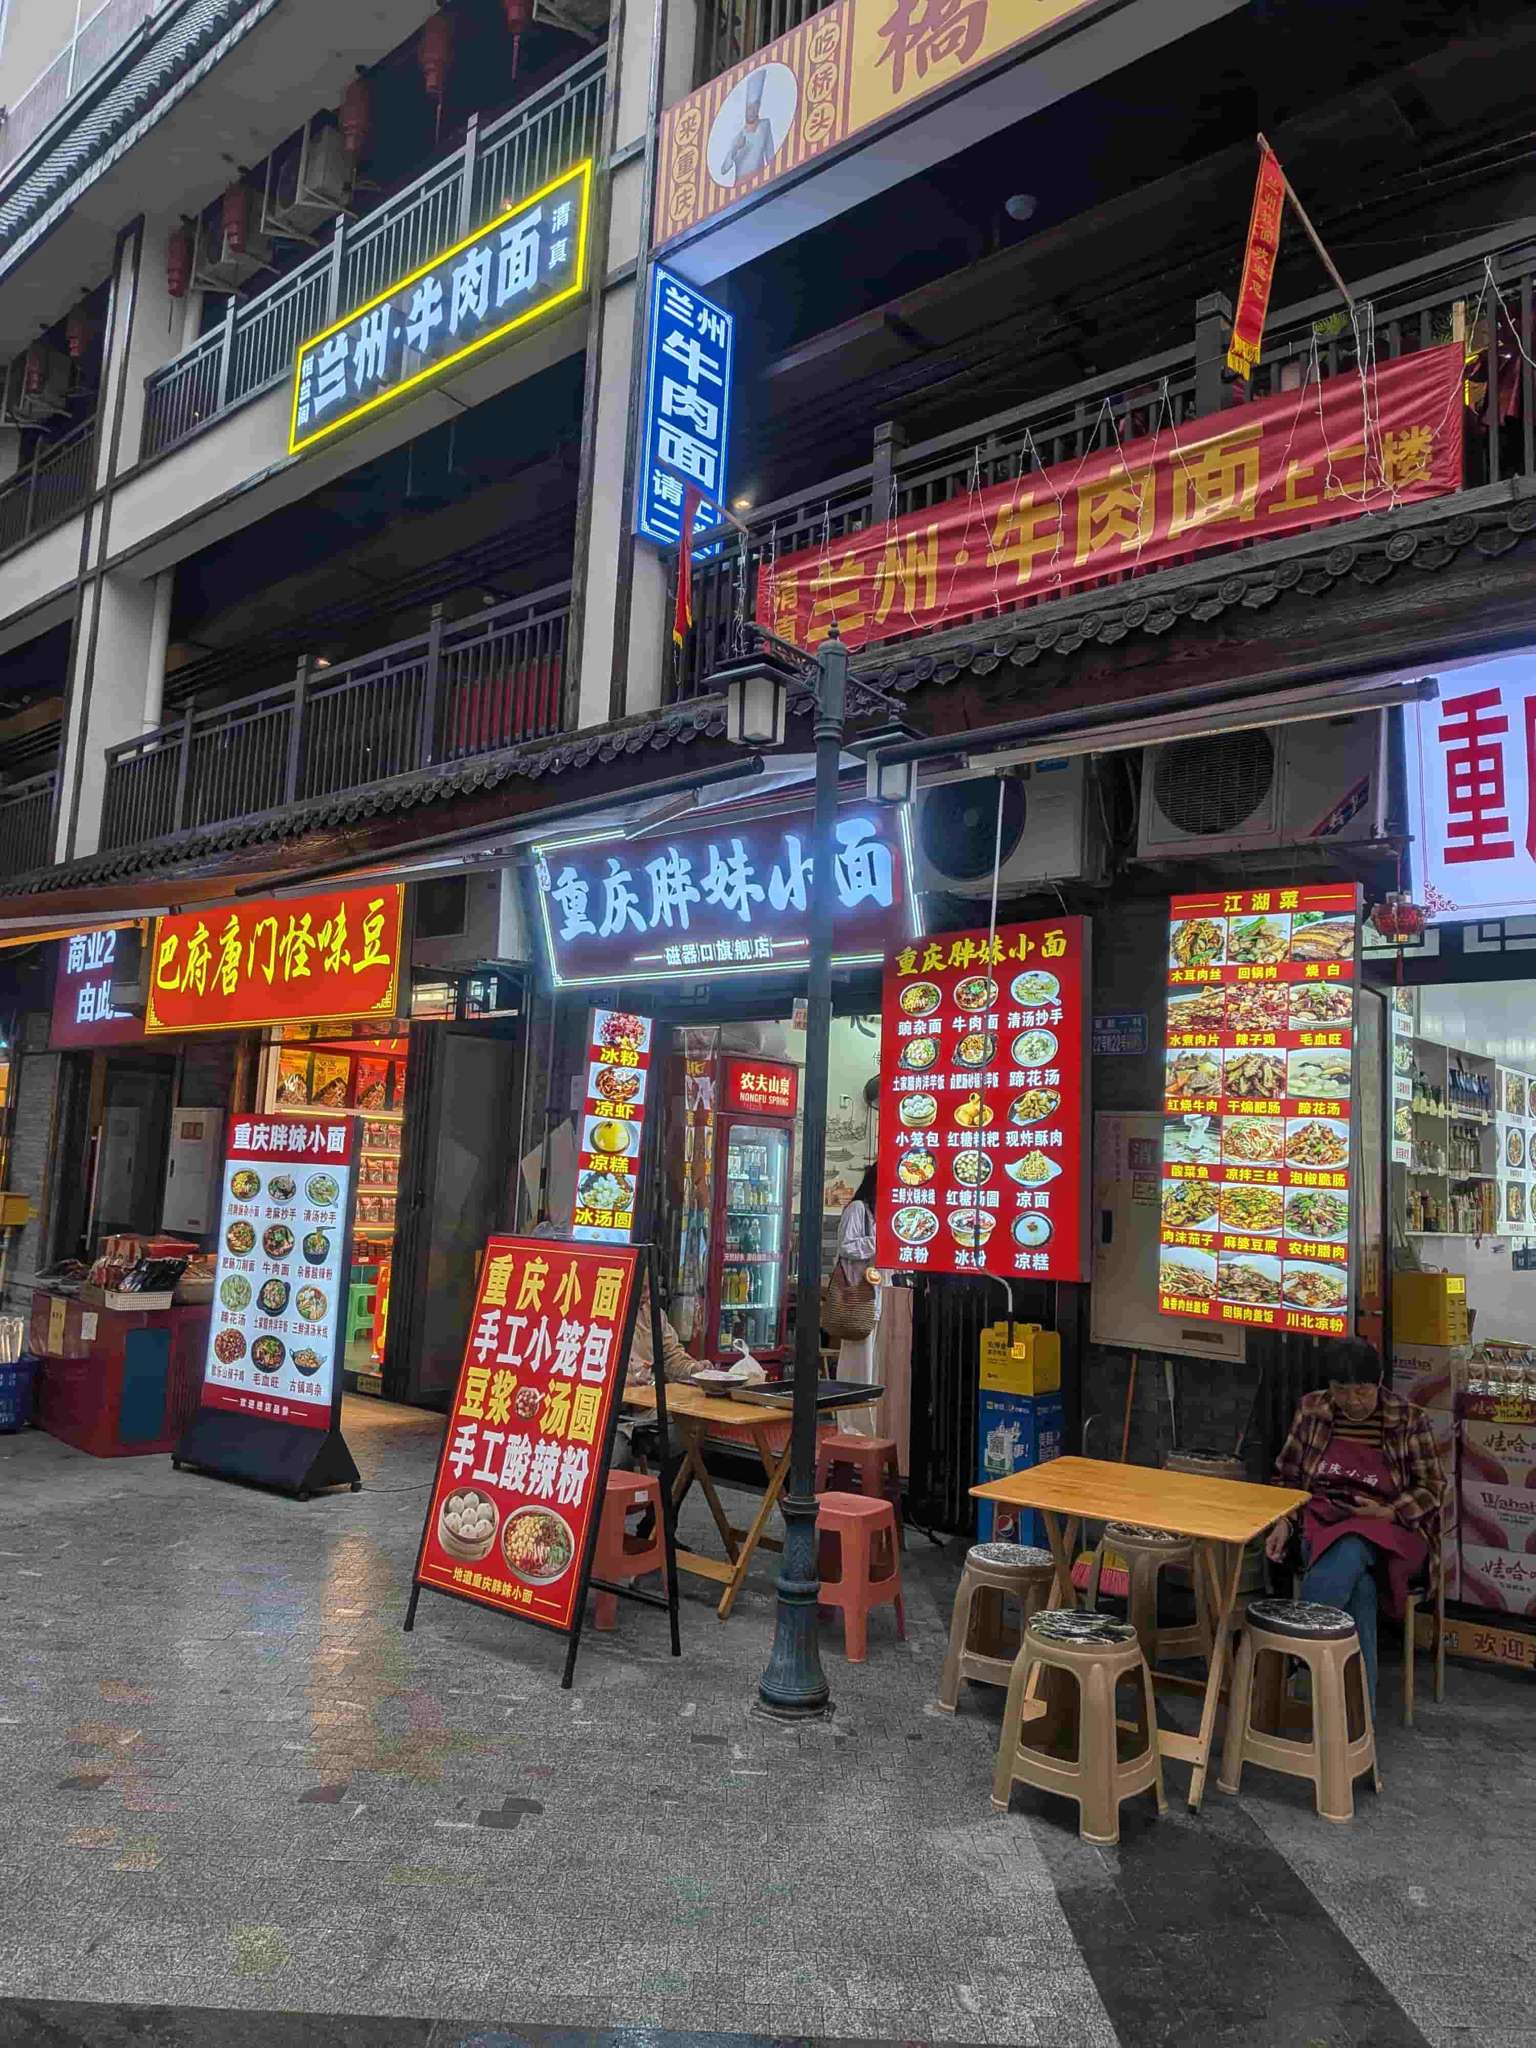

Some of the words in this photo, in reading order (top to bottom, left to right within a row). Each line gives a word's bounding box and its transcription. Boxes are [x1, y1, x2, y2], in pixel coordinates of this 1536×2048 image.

[673, 110, 699, 216] 来重庆
[548, 200, 571, 270] 清真
[663, 285, 726, 349] 兰州
[657, 329, 723, 490] 牛肉面
[1438, 687, 1536, 866] 重
[552, 817, 894, 942] 重庆胖妹小面
[1223, 890, 1300, 913] 江湖菜
[156, 898, 391, 999] 巴府唐门怪味豆
[664, 936, 774, 966] 磁器口旗舰店
[895, 929, 1068, 977] 重庆胖妹小面
[1170, 968, 1223, 982] 木耳肉丝
[1237, 967, 1278, 980] 回锅肉
[951, 1013, 1000, 1032] 牛肉面
[1007, 1007, 1064, 1029] 清汤抄手
[1169, 1034, 1221, 1047] 水煮肉片
[1235, 1033, 1276, 1046] 辣子鸡
[1299, 1033, 1343, 1046] 毛血旺
[599, 1046, 640, 1068] 冰粉
[740, 1072, 790, 1096] 农夫山泉
[1009, 1069, 1061, 1088] 蹄花汤
[594, 1100, 636, 1122] 凉虾
[1167, 1100, 1218, 1114] 红烧牛肉
[1227, 1100, 1281, 1115] 干煸肥肠
[1297, 1101, 1342, 1117] 蹄花汤
[232, 1122, 346, 1154] 重庆胖妹小面
[895, 1131, 940, 1148] 小笼包
[1005, 1129, 1064, 1148] 现炸酥肉
[587, 1153, 631, 1174] 凉糕
[1171, 1164, 1209, 1179] 酸菜鱼
[1225, 1167, 1280, 1184] 凉拌三丝
[1015, 1191, 1050, 1209] 凉面
[574, 1207, 633, 1230] 冰汤圆
[1162, 1230, 1214, 1245] 肉沫茄子
[1223, 1236, 1278, 1254] 麻婆豆腐
[898, 1247, 929, 1264] 凉粉
[1014, 1252, 1050, 1271] 凉糕
[1288, 1241, 1346, 1261] 农村腊肉
[262, 1261, 290, 1277] 牛肉面
[481, 1253, 625, 1321] 重庆小面
[1286, 1311, 1345, 1334] 川北凉粉
[472, 1308, 613, 1383] 手工小笼包
[253, 1373, 280, 1389] 毛血旺
[458, 1366, 518, 1426] 豆浆
[539, 1378, 602, 1446] 汤圆
[448, 1422, 590, 1509] 手工酸辣粉
[452, 1567, 534, 1605] 地道重庆胖妹小面
